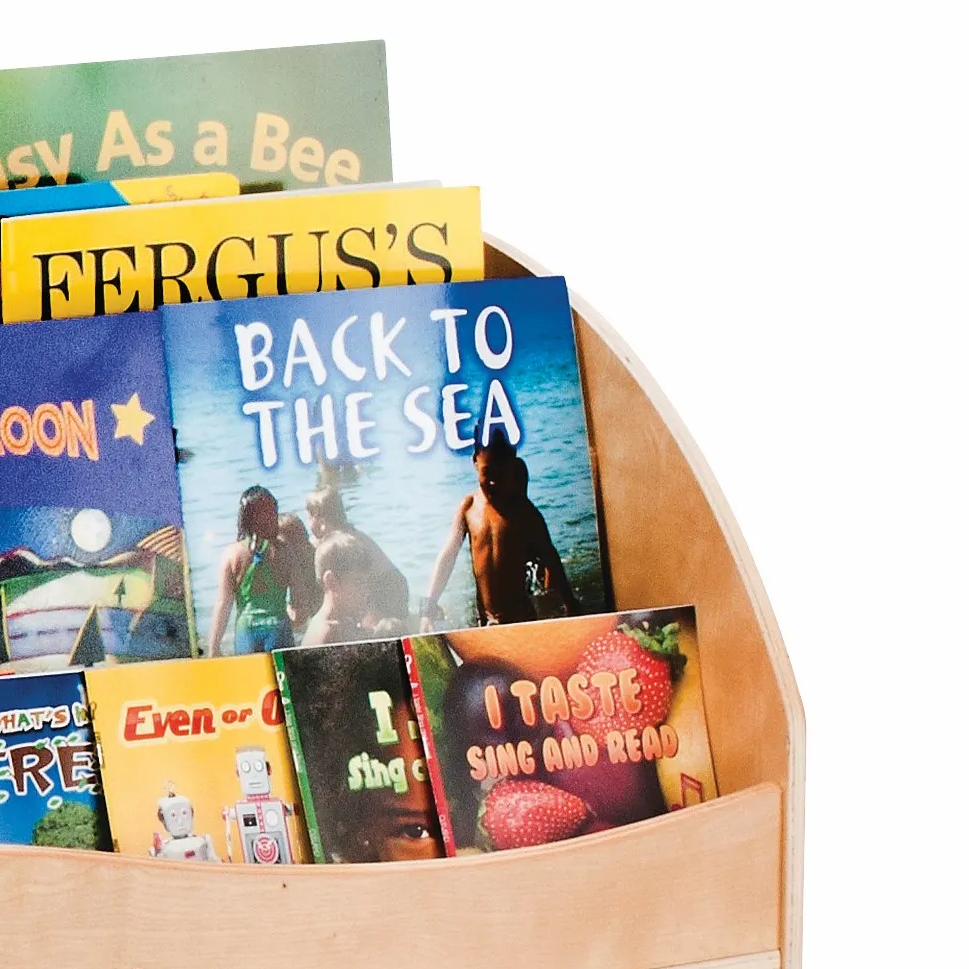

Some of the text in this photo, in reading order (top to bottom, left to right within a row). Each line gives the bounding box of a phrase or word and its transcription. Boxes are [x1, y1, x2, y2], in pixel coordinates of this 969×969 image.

[96, 109, 175, 172] As
[193, 120, 228, 166] a
[250, 112, 362, 185] Bee
[33, 222, 452, 320] FERGUS'S
[234, 305, 513, 391] BACK TO
[242, 379, 522, 468] THE SEA
[125, 705, 216, 740] Even
[222, 707, 253, 725] or
[262, 688, 284, 727] O
[368, 691, 398, 744] I
[484, 685, 504, 730] I
[510, 668, 642, 728] TASTE
[467, 724, 680, 781] SING AND READ
